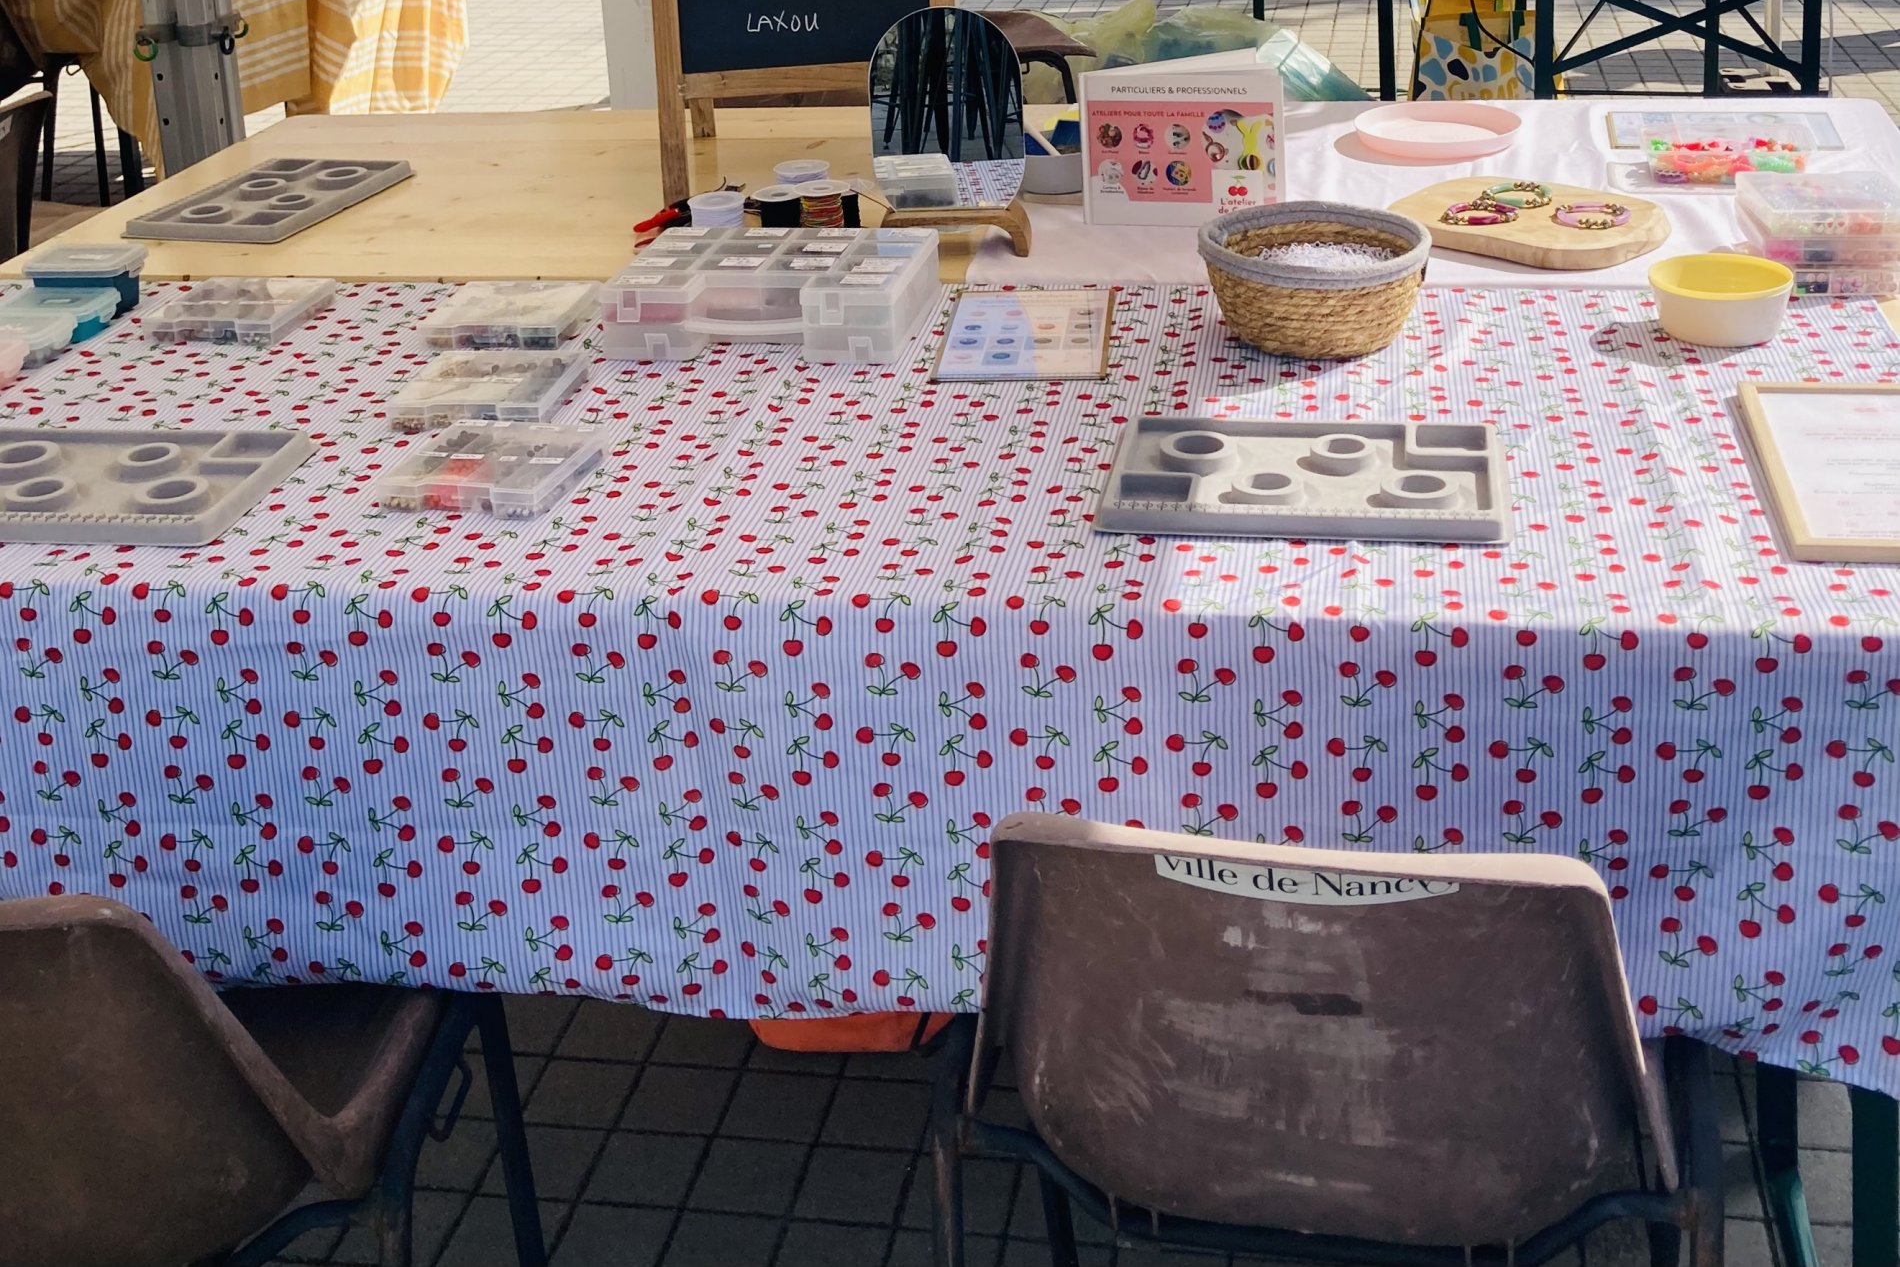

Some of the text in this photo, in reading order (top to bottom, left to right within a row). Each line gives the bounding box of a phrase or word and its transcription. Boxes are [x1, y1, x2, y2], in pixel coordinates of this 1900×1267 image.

[746, 10, 820, 33] LAXOU
[1110, 86, 1248, 95] PARTICULIERS & PROFESSIONNELS
[1220, 197, 1257, 206] L'atelier
[1218, 205, 1229, 214] de
[1162, 854, 1239, 886] Ville
[1252, 867, 1299, 894] de
